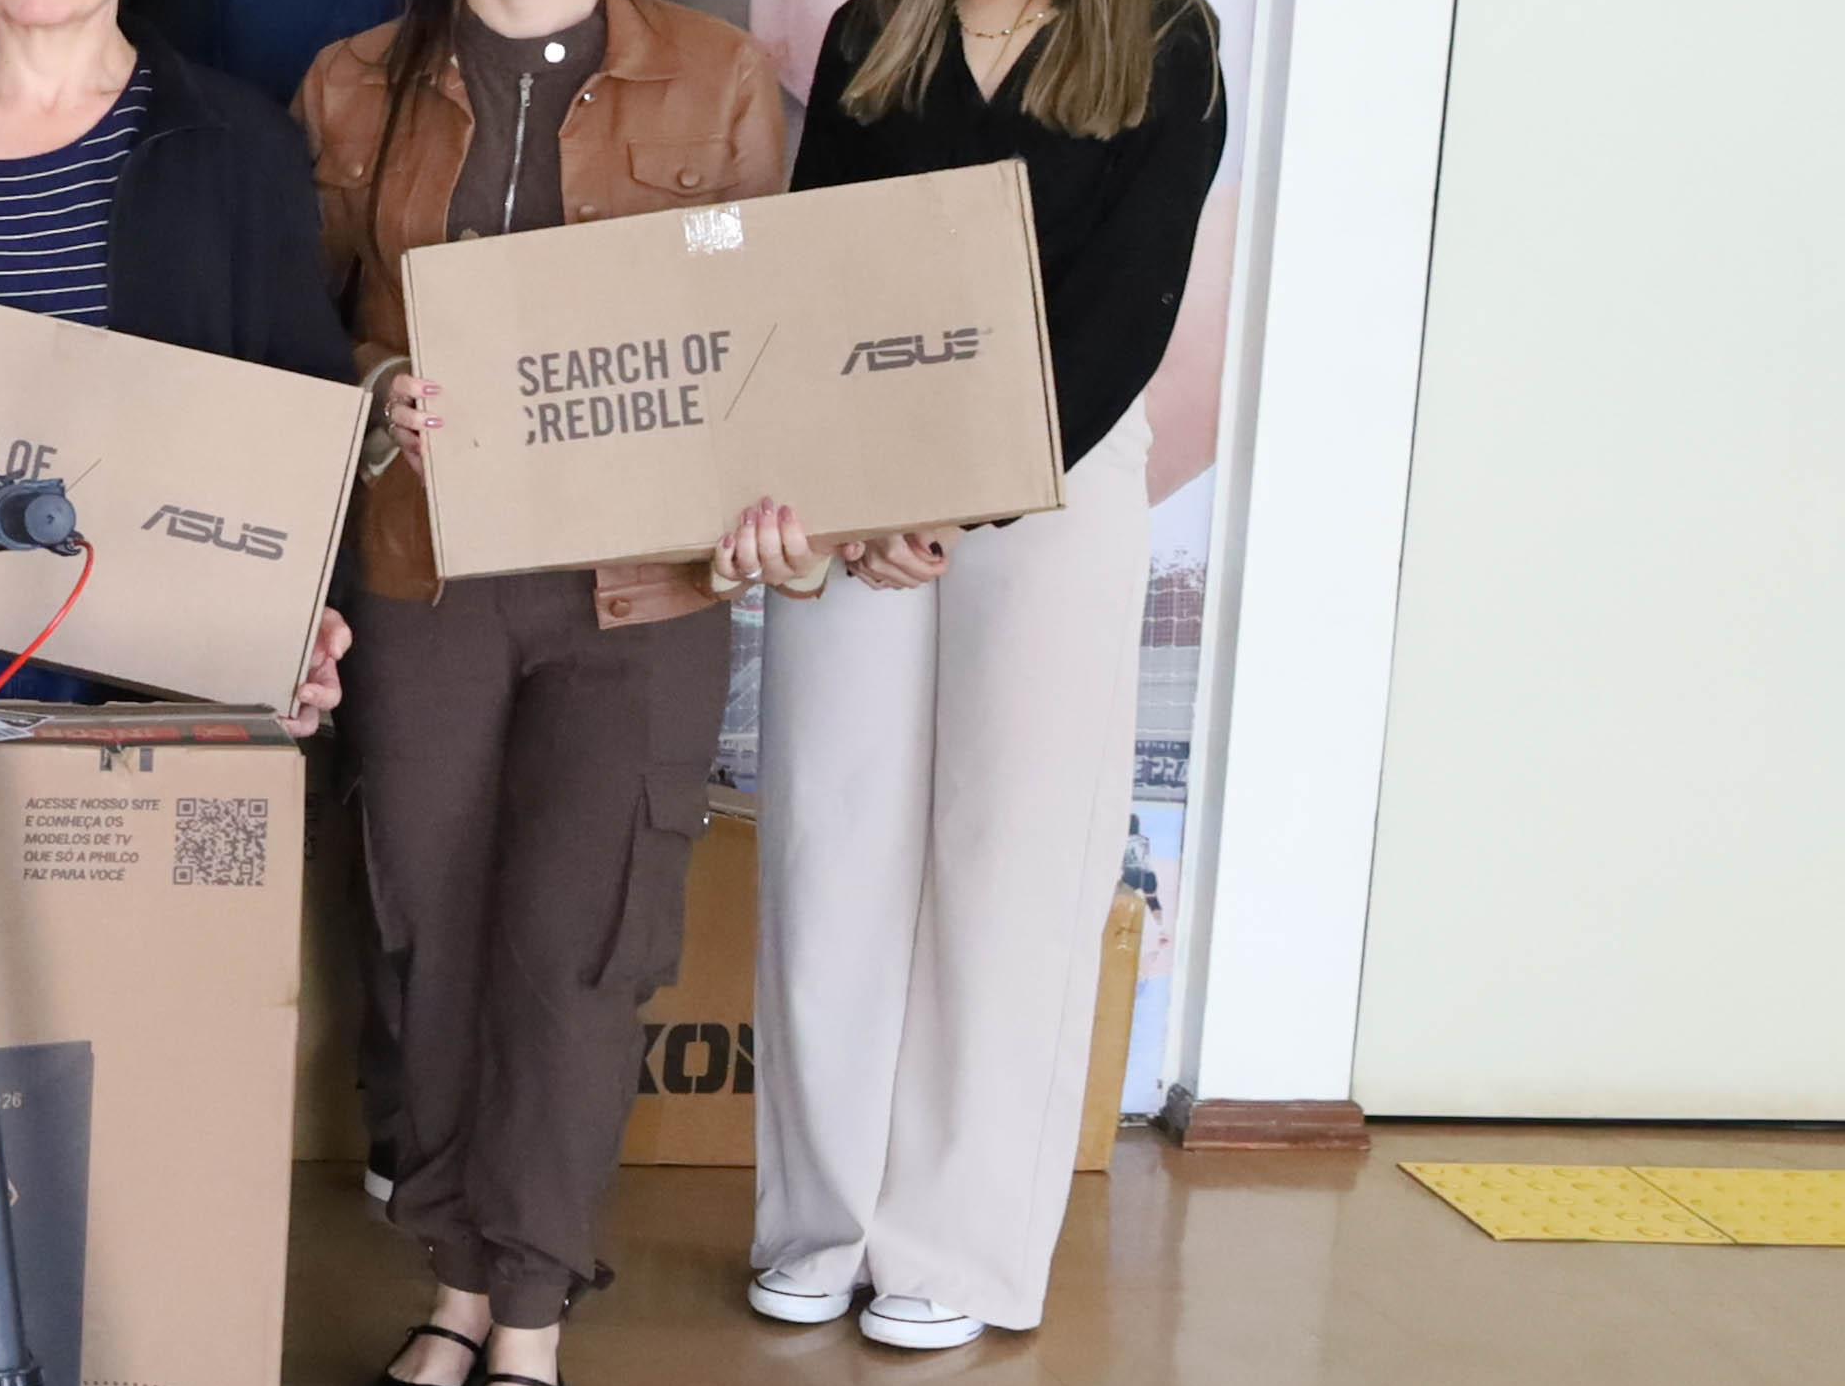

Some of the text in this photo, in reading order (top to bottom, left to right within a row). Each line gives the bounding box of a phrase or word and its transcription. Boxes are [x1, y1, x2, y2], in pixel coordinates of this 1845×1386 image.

[840, 327, 979, 375] ASUS
[517, 330, 732, 397] SEARCH OF
[6, 439, 58, 482] OF
[141, 504, 287, 561] ASUS
[25, 798, 161, 811] ACESSE NOSSO SITE
[25, 816, 124, 829] E CONHEÇA OS
[24, 833, 132, 845] MODELOS DE TV
[24, 849, 139, 863] QUE SÓ A PHILCO
[24, 867, 125, 881] FAZ PARA VOCÊ
